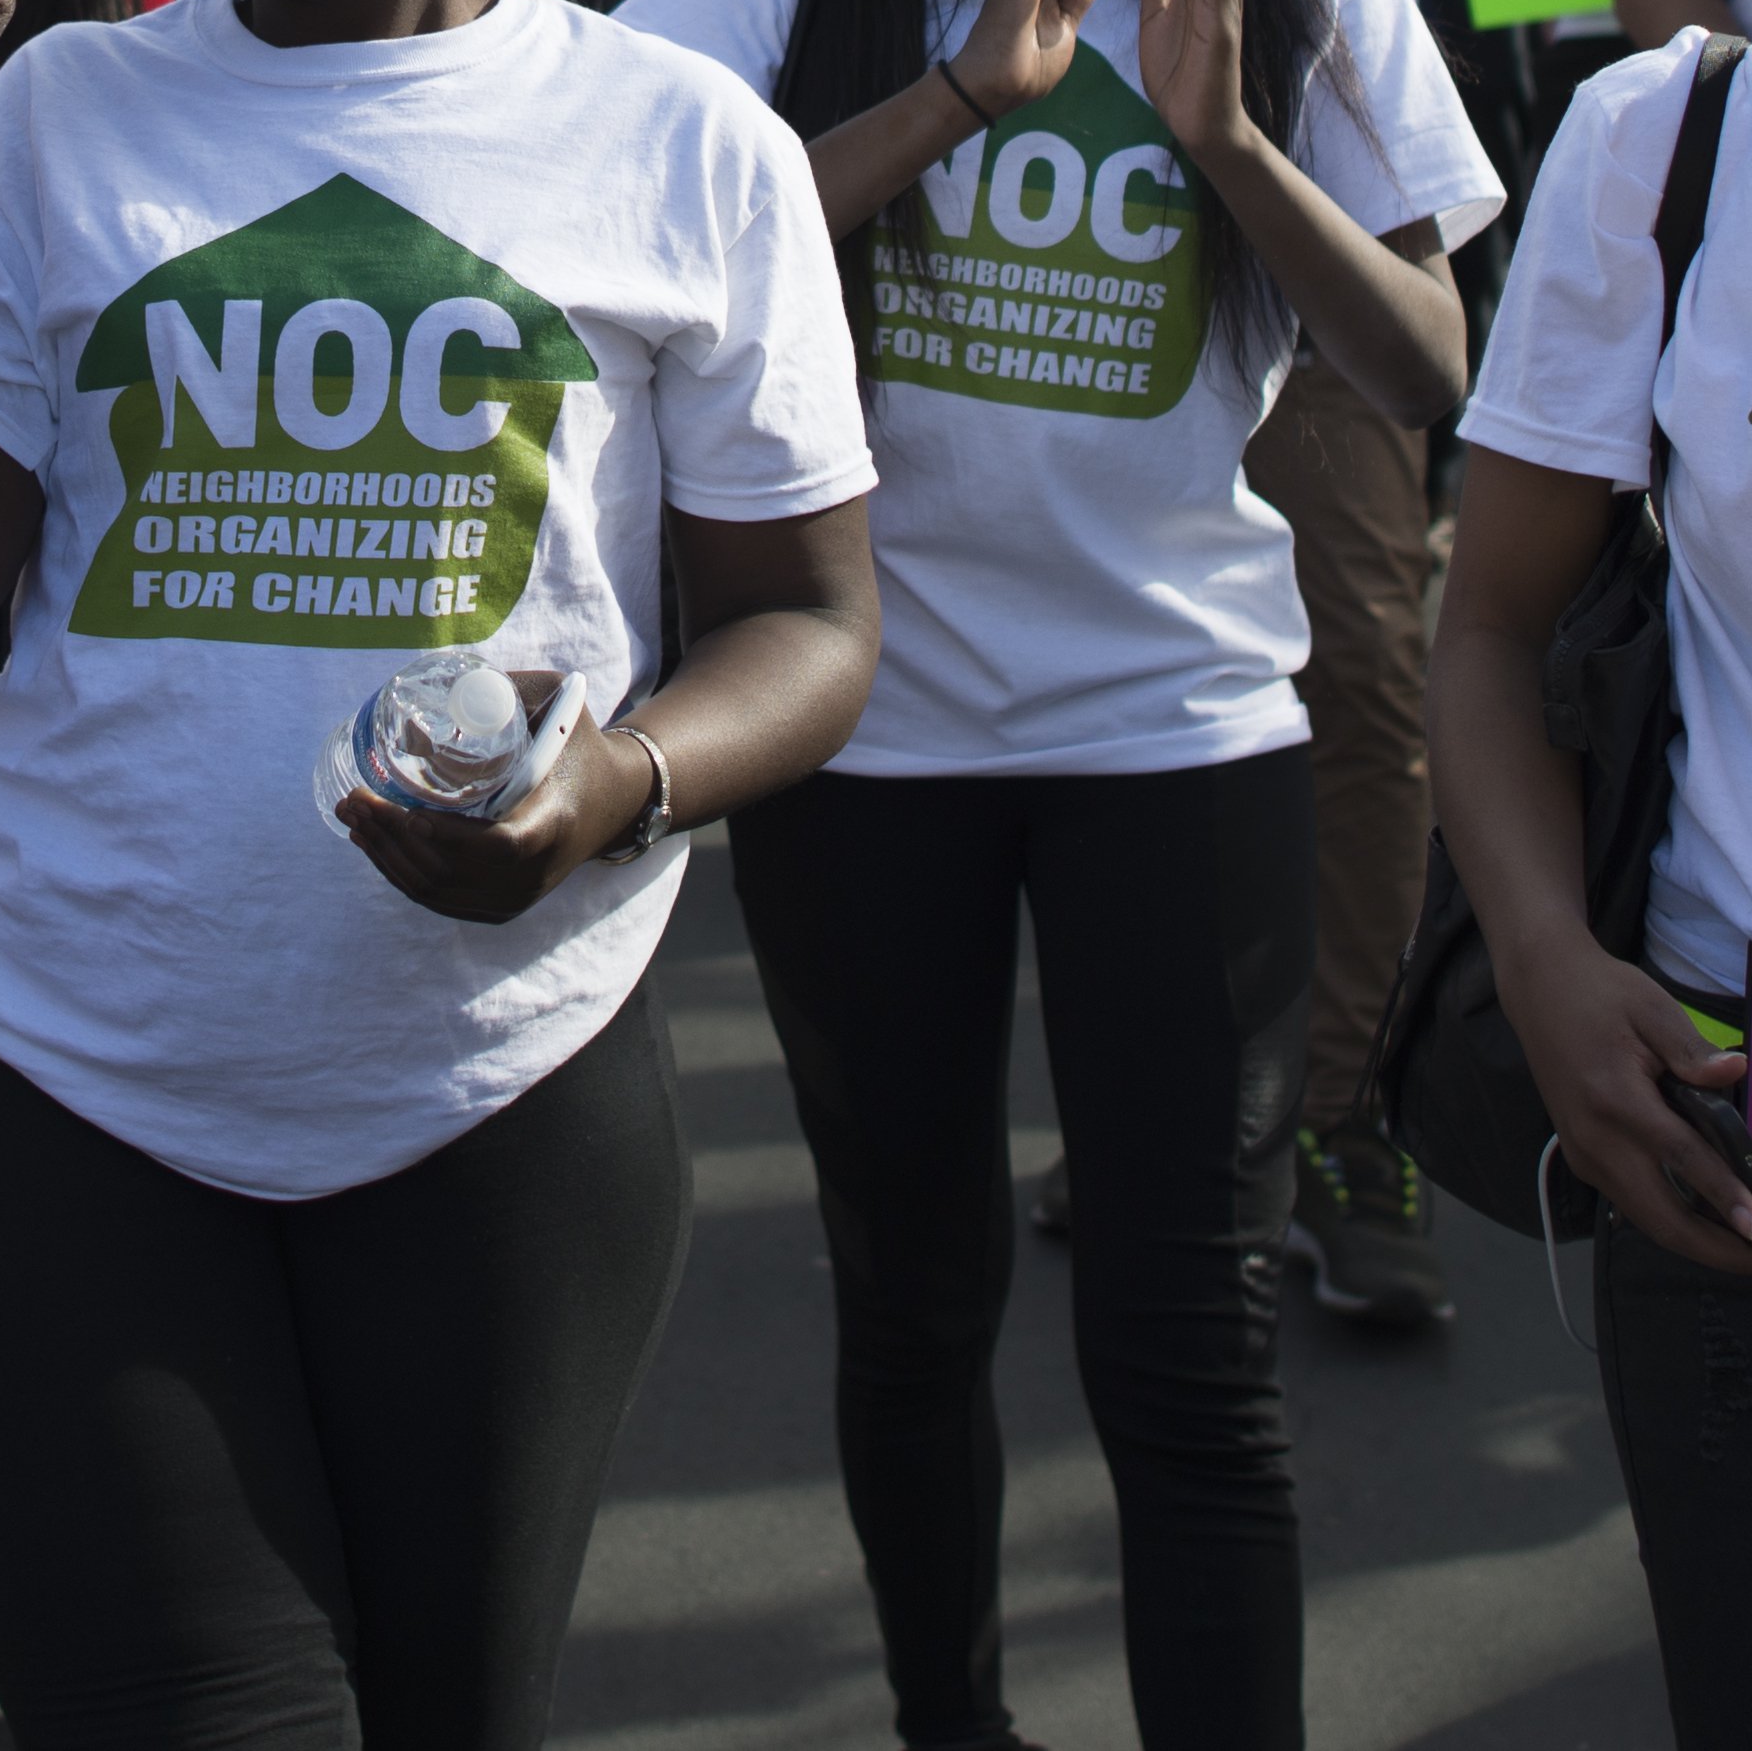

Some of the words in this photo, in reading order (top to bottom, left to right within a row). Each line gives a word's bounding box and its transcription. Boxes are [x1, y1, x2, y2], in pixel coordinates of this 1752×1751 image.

[873, 246, 1167, 310] NEIGHBORHOODS
[872, 282, 1157, 350] ORGANIZING
[145, 296, 522, 452] NOC
[871, 326, 954, 367] FOR
[965, 341, 1152, 395] CHANGE
[139, 470, 496, 508] NEIGHBORHOODS
[133, 515, 488, 560] ORGANIZING
[132, 570, 238, 610] FOR
[251, 571, 482, 617] CHANGE
